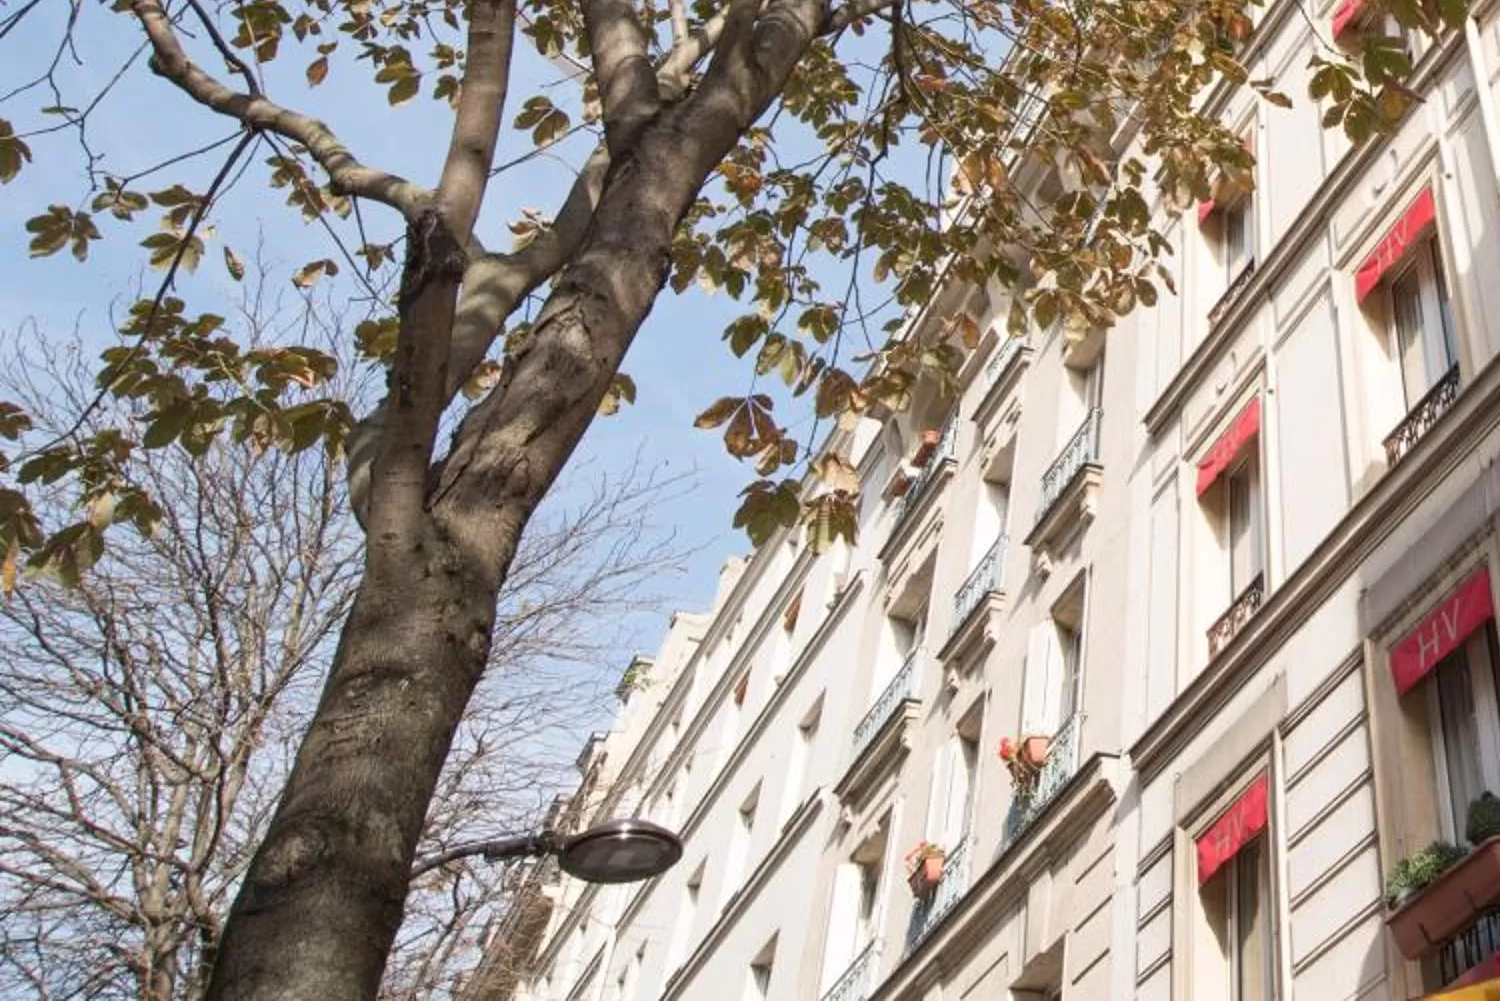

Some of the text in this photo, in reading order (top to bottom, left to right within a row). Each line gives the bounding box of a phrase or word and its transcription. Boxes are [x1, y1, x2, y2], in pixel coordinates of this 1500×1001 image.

[1375, 215, 1408, 274] HV
[1417, 598, 1459, 668] HV
[1215, 801, 1248, 856] HV
